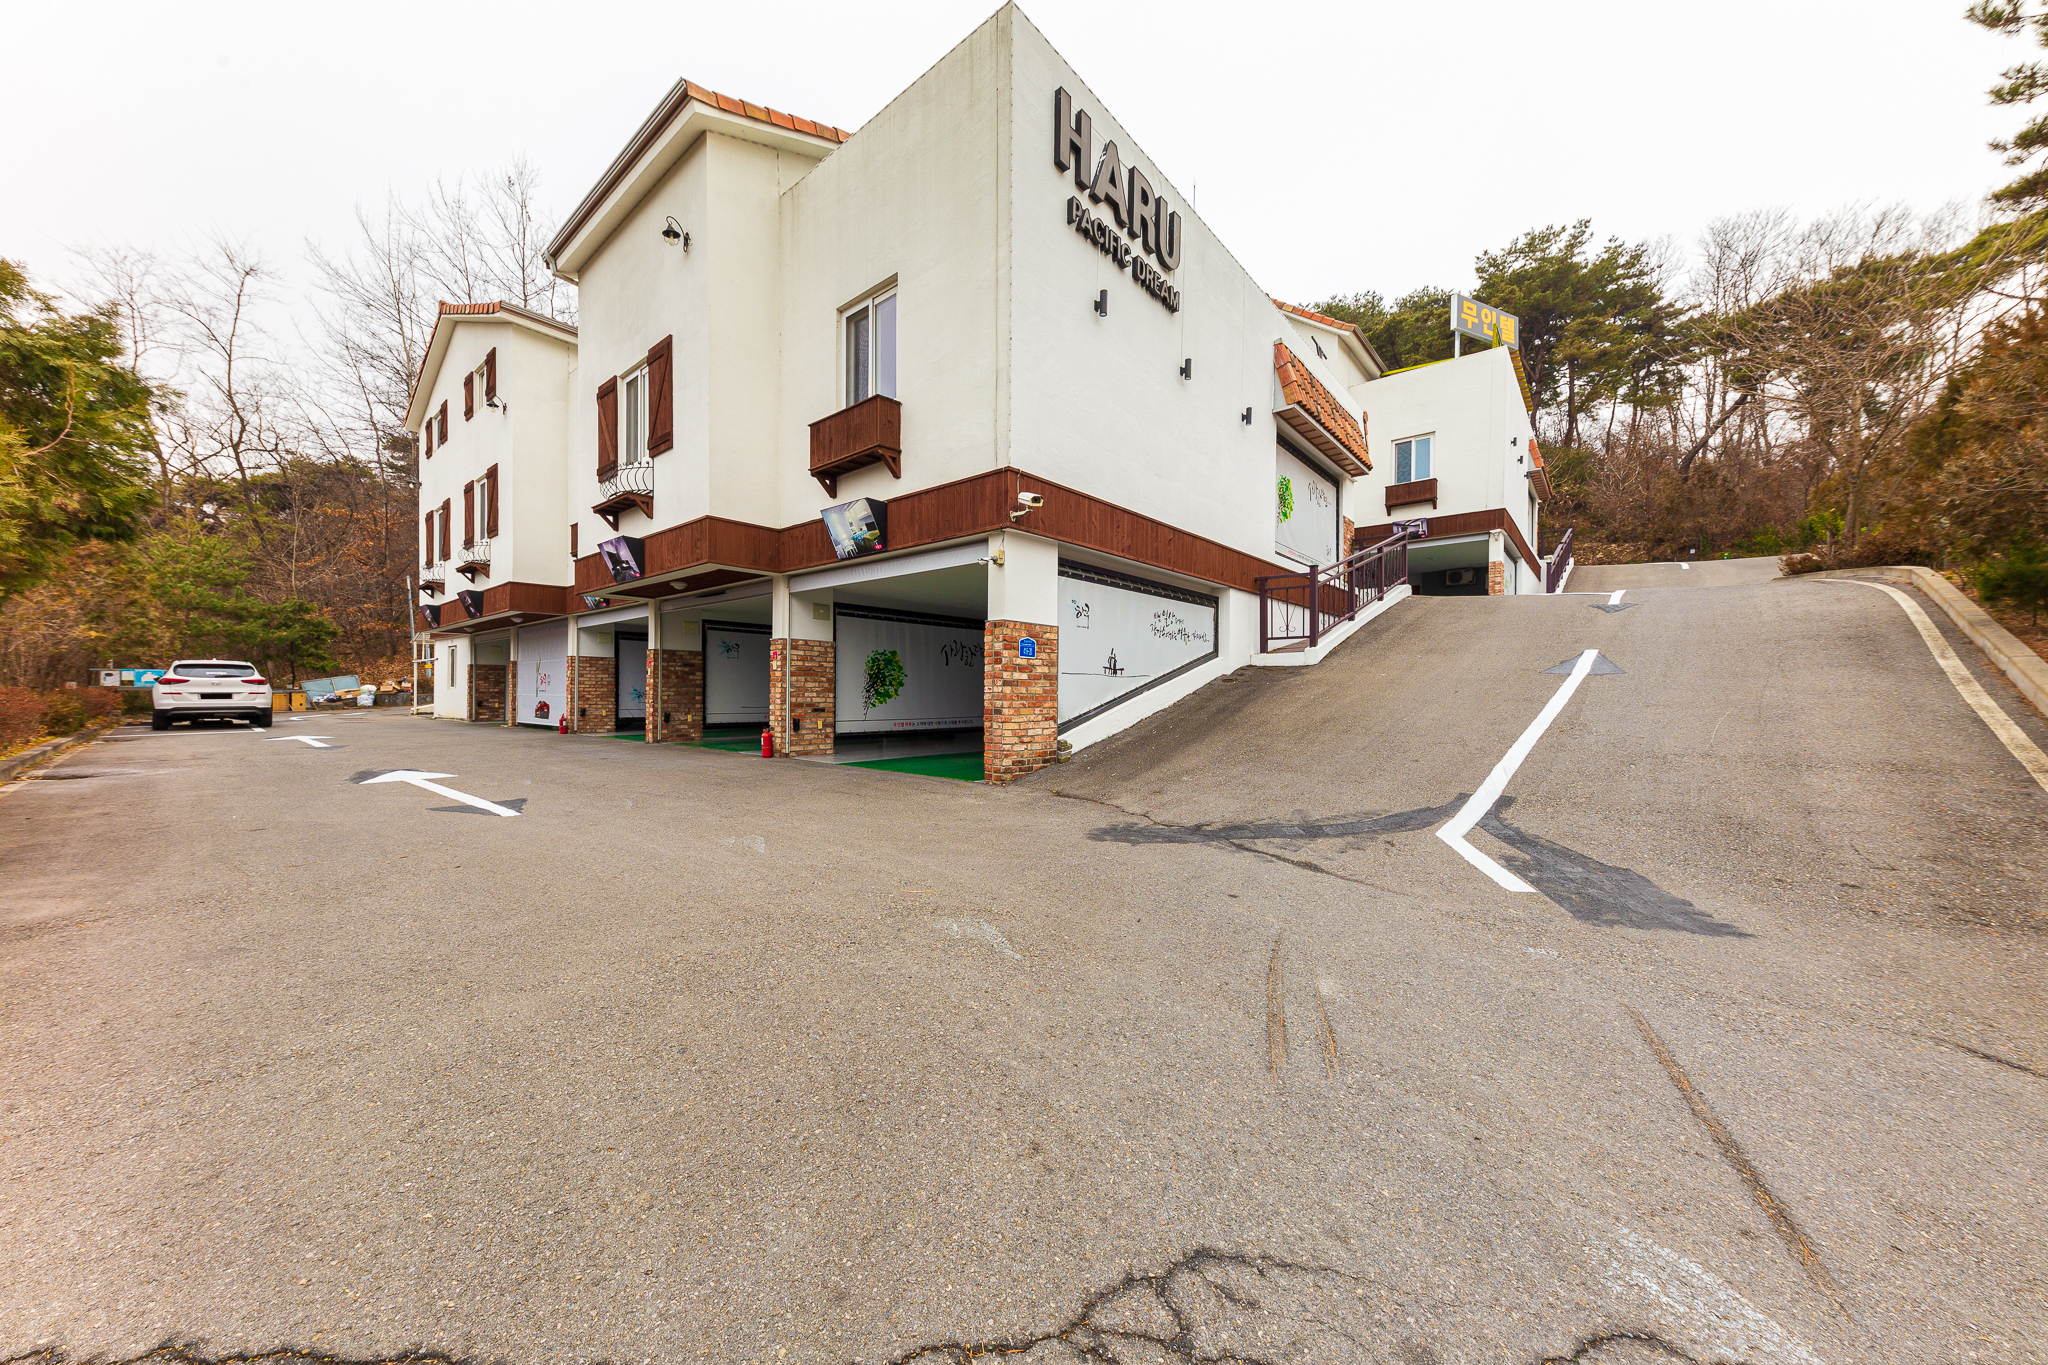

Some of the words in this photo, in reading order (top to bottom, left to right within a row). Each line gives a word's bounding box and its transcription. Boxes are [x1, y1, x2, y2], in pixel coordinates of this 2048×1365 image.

[1054, 86, 1182, 272] HARU
[1067, 196, 1132, 269] PACIFIC
[1132, 255, 1181, 314] DREAM
[1460, 300, 1516, 345] 무인텔
